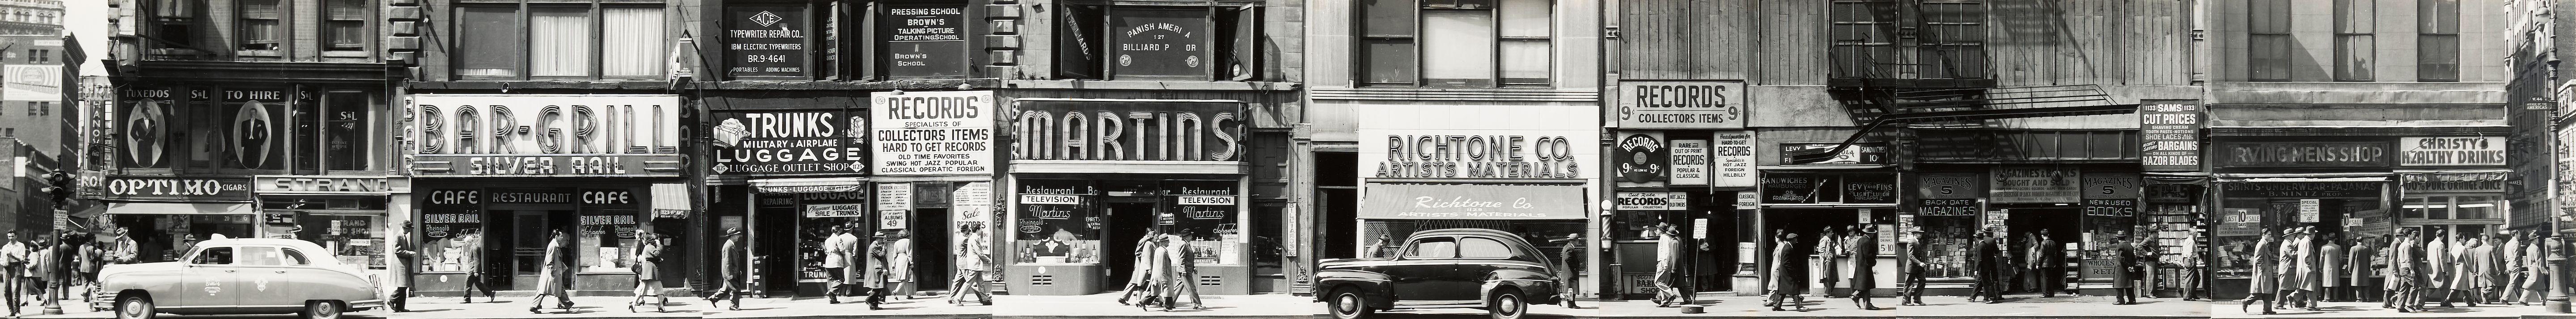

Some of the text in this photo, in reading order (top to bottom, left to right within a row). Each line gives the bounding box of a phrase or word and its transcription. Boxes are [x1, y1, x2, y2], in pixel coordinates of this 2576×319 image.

[756, 12, 774, 25] ACE
[126, 89, 169, 98] TUXEDOS
[191, 90, 208, 99] S&L
[225, 91, 280, 100] TO HIRE
[1637, 85, 1725, 108] RECORDS
[889, 96, 978, 119] RECORDS
[341, 111, 357, 120] S&L
[1639, 113, 1723, 123] COLLECTORS ITEMS
[2144, 113, 2195, 125] CUT PRICES
[746, 112, 834, 138] TRUNKS
[879, 129, 988, 141] COLLECTORS ITEMS
[1021, 110, 1236, 161] MARTINS
[883, 142, 986, 152] HARD TO GET RECORDS
[1388, 134, 1575, 161] RICHTONE CO.
[1718, 146, 1750, 156] RECORDS
[2158, 141, 2197, 151] BARGAINS
[717, 147, 861, 162] LUGGAGE
[1673, 155, 1704, 165] RECORDS
[470, 157, 625, 175] SILVER RAIL
[2143, 156, 2198, 166] RAZOR BLADES
[1376, 161, 1578, 178] ARTISTS MATERIALS
[109, 179, 221, 195] OPTIMO
[275, 178, 390, 192] STRAND
[1923, 177, 1972, 190] MAGAZINES
[2084, 177, 2133, 191] MAGAZINES
[432, 190, 477, 204] CAFE
[493, 193, 571, 202] RESTAURANT
[583, 191, 627, 204] CAFE
[1618, 197, 1667, 206] RECORDS
[1919, 207, 1975, 216] MAGAZINES
[2087, 206, 2132, 216] BOOKS
[425, 214, 479, 223] SILVER RAIL
[581, 215, 635, 225] SILVER RAIL
